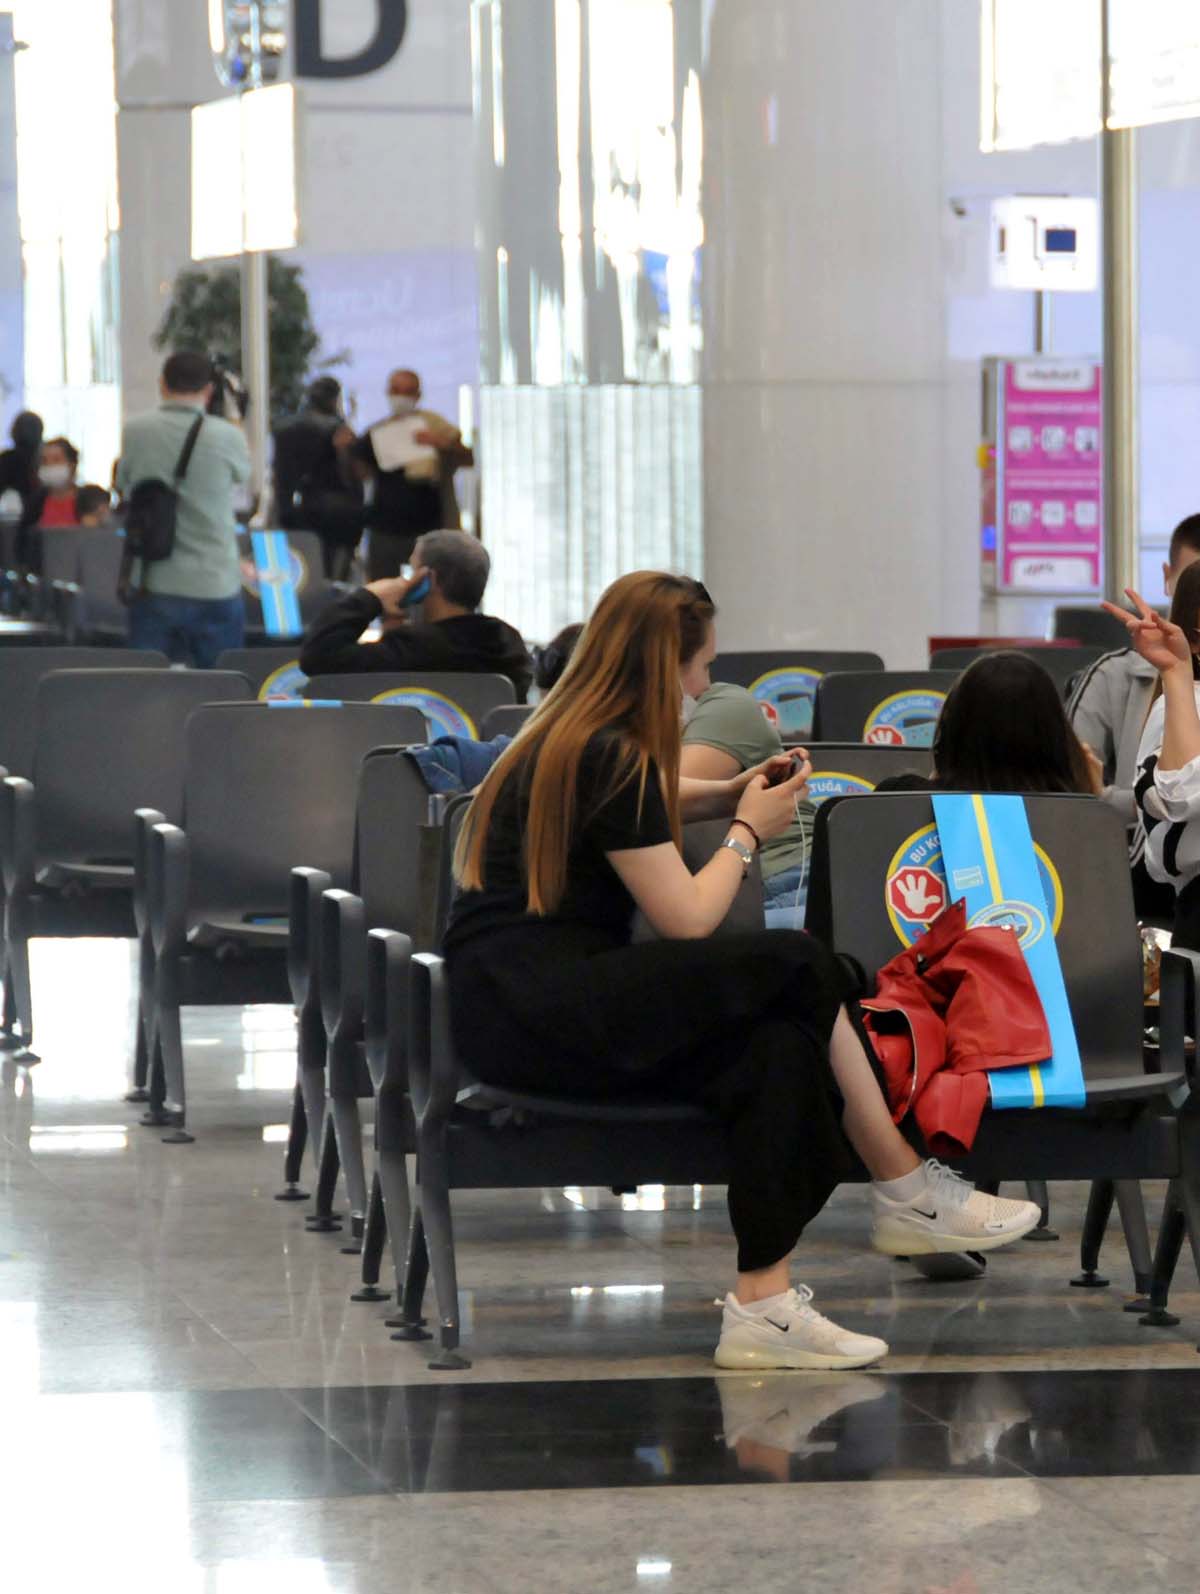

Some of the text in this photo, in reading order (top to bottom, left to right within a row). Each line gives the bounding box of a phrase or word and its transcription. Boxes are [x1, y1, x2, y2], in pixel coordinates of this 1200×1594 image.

[296, 0, 407, 77] D
[809, 780, 842, 793] TUĞA
[909, 845, 927, 864] BU
